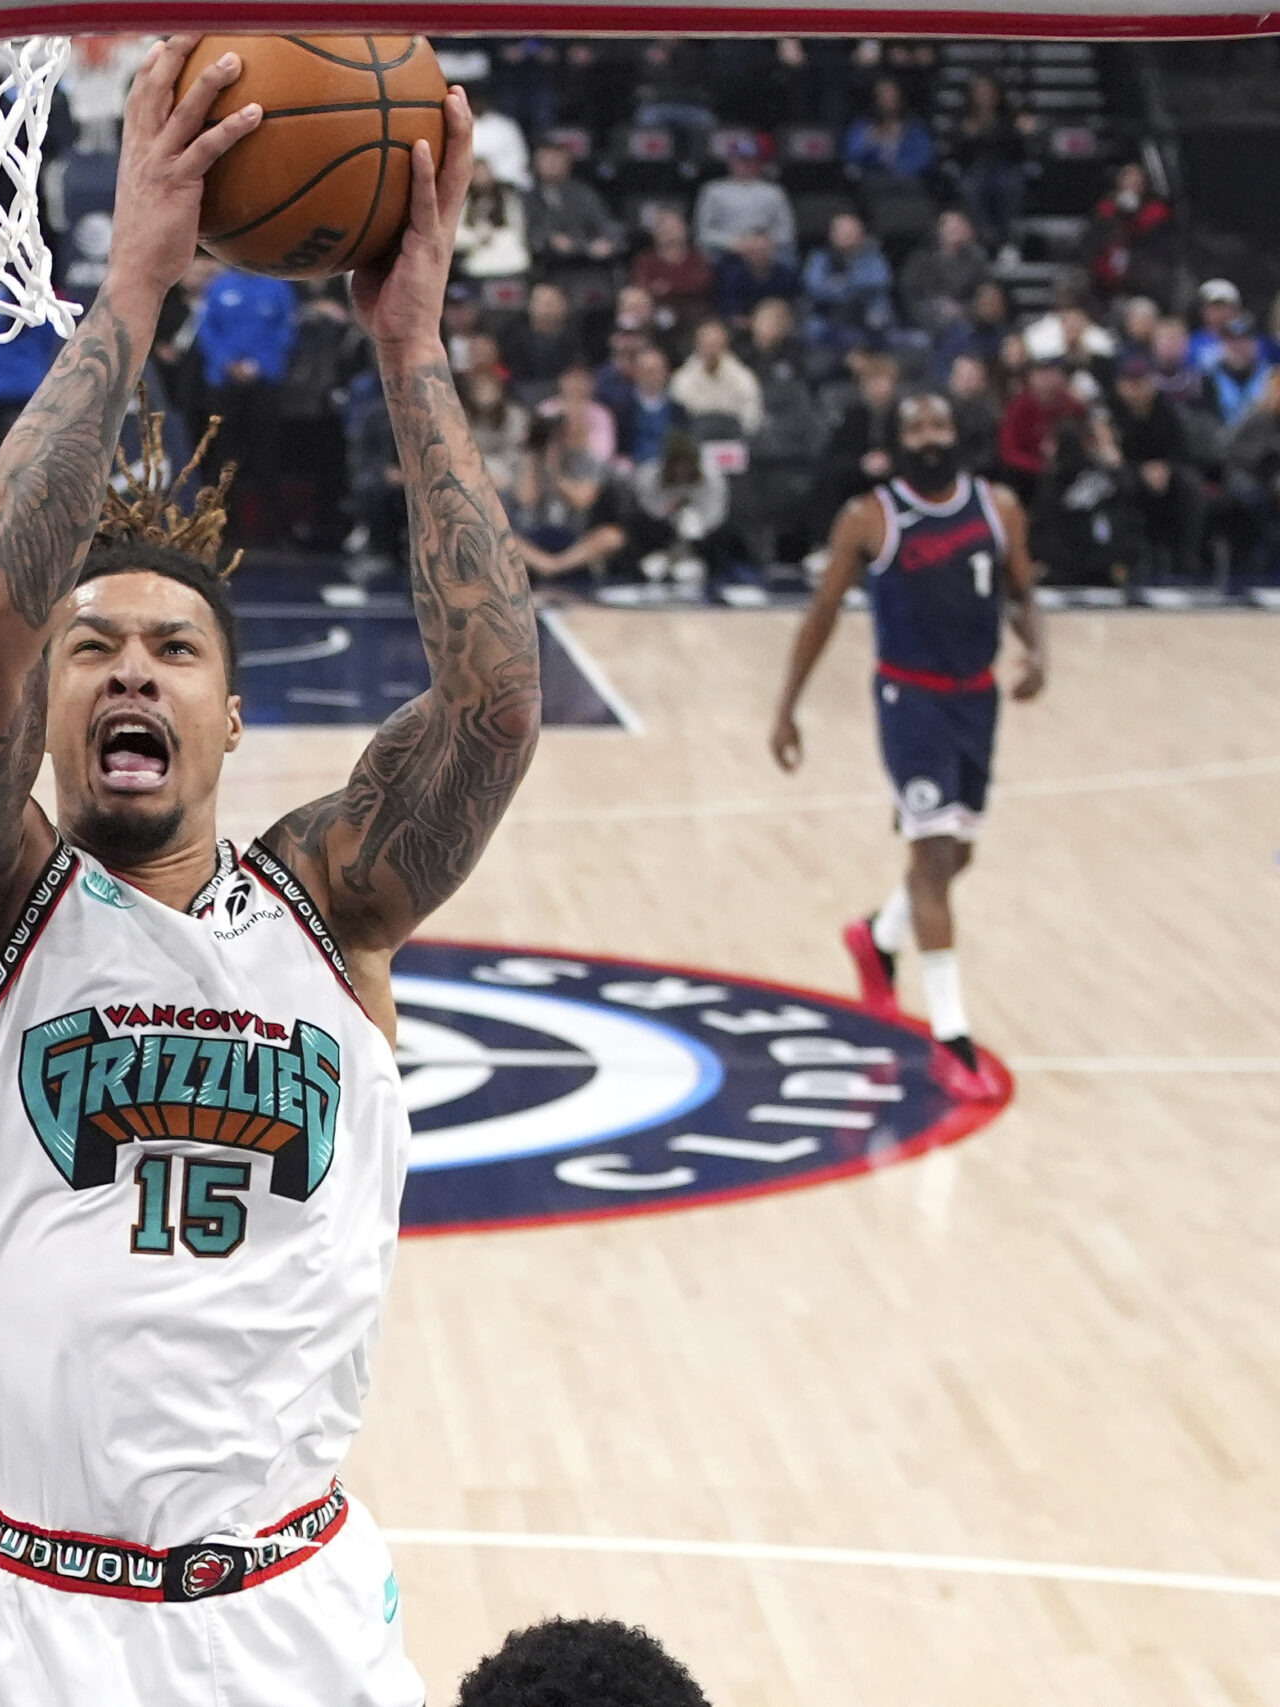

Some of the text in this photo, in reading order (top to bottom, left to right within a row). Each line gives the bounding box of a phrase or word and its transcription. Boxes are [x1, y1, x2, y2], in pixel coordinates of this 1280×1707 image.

[968, 550, 993, 598] 1
[213, 905, 284, 941] Robinhood
[20, 1006, 341, 1202] GRIZZLIES
[130, 1154, 251, 1258] 15
